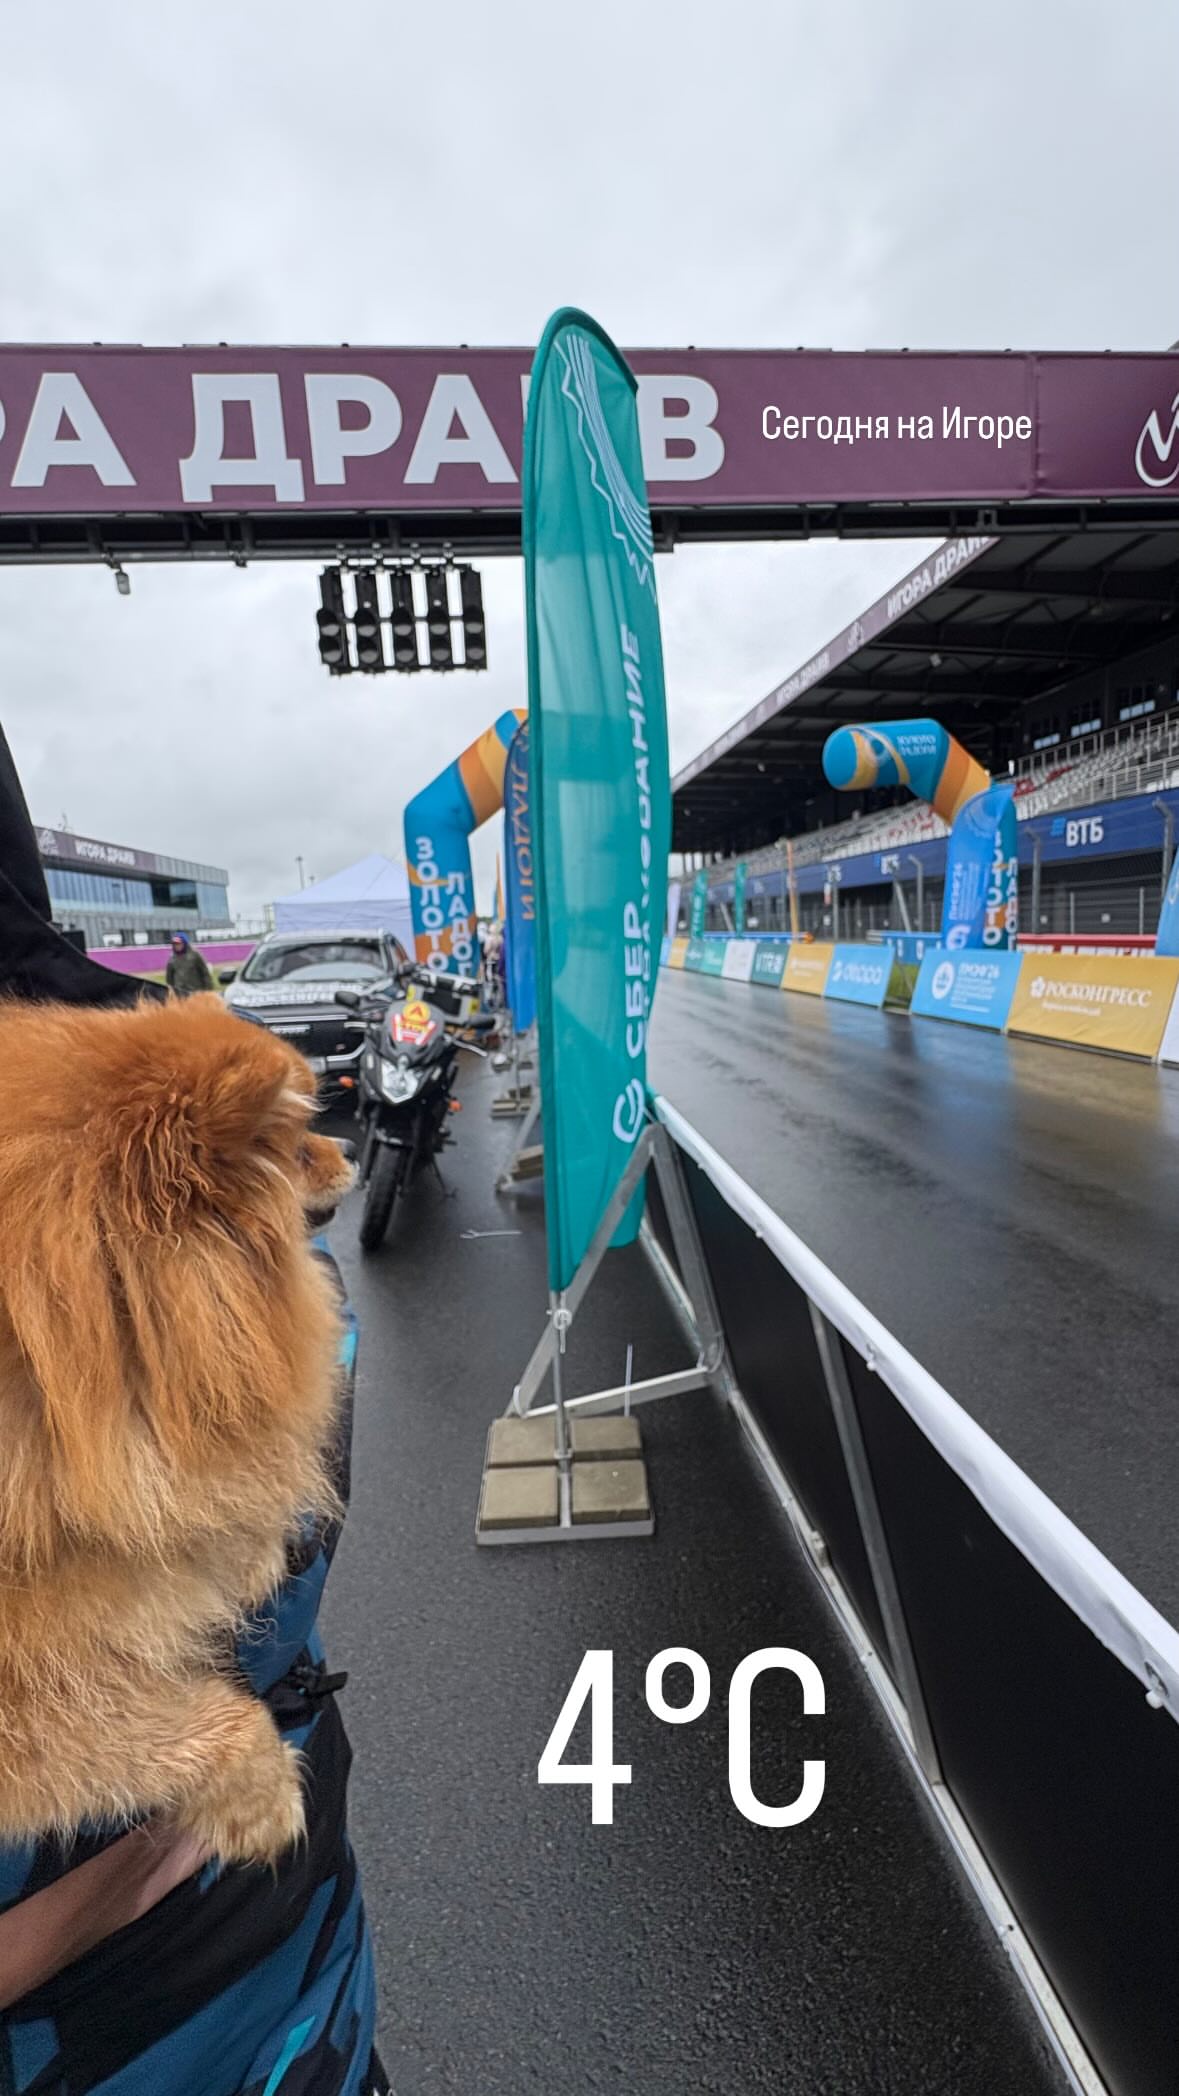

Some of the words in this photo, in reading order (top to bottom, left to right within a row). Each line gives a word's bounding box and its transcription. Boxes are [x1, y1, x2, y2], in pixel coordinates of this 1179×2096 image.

[0, 373, 137, 486] А
[179, 373, 725, 502] ДРАВ
[887, 568, 932, 618] ИГОРА
[1066, 816, 1104, 847] ВТБ
[416, 837, 449, 972] ЗОЛОТО
[623, 901, 644, 1058] СБЕР
